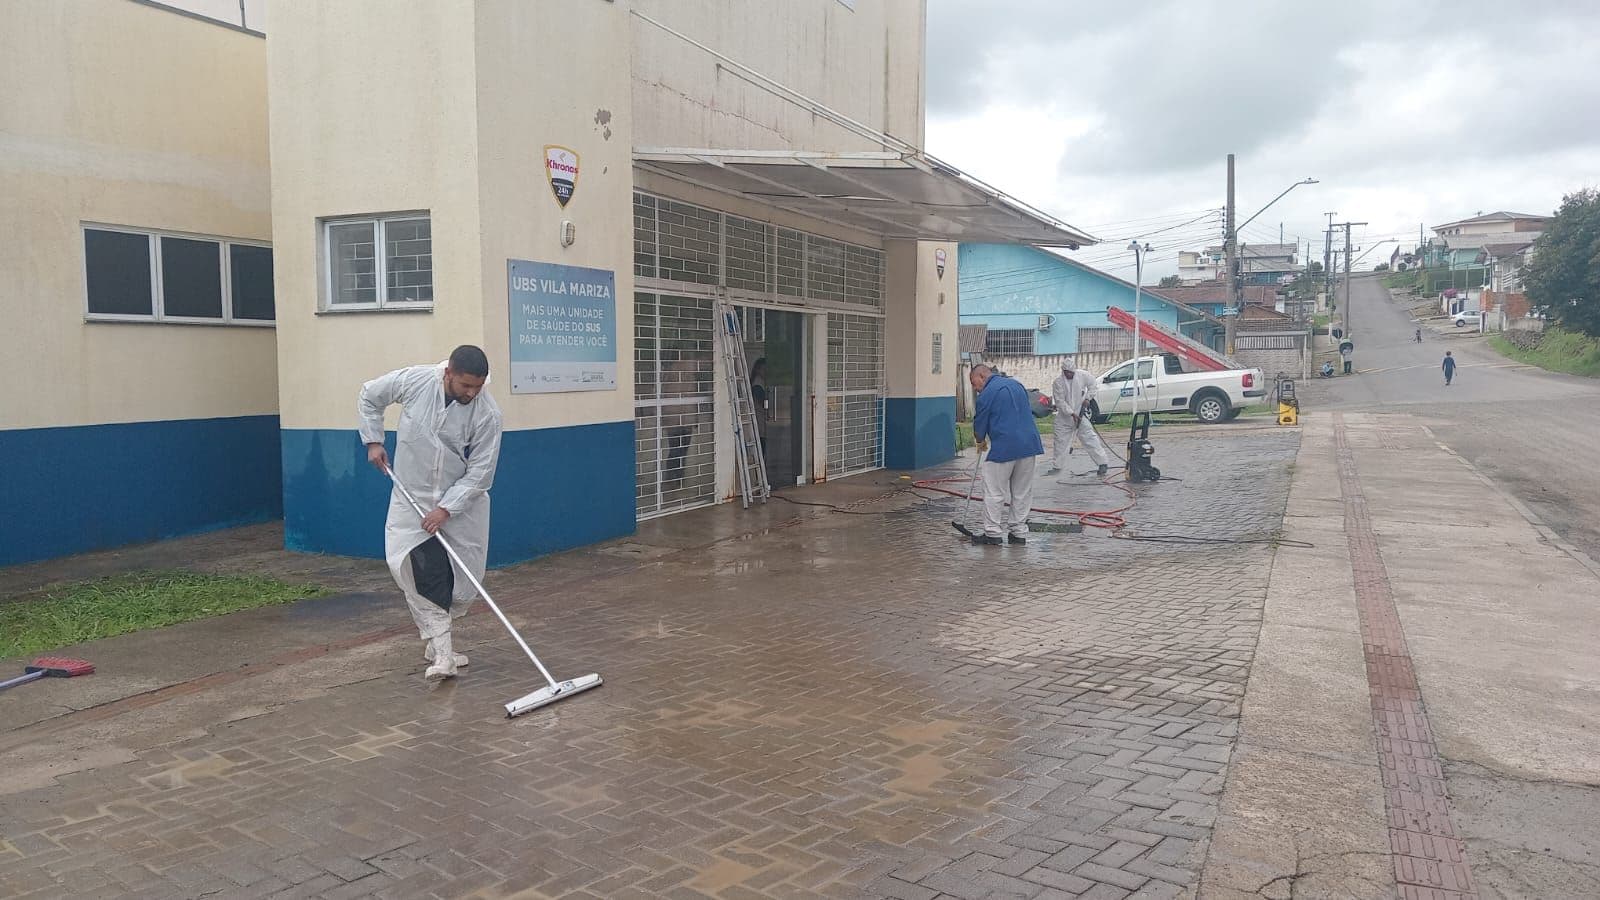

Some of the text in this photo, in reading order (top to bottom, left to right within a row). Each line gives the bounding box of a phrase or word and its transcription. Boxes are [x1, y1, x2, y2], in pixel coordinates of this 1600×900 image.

[558, 186, 569, 195] 24h
[512, 276, 610, 299] UBS VILA MARIZA
[522, 303, 604, 319] MAIS UMA UNIDADE
[526, 318, 601, 333] DE SAÚDE DO SUS
[519, 334, 608, 347] PARA ATENDER VOCÊ
